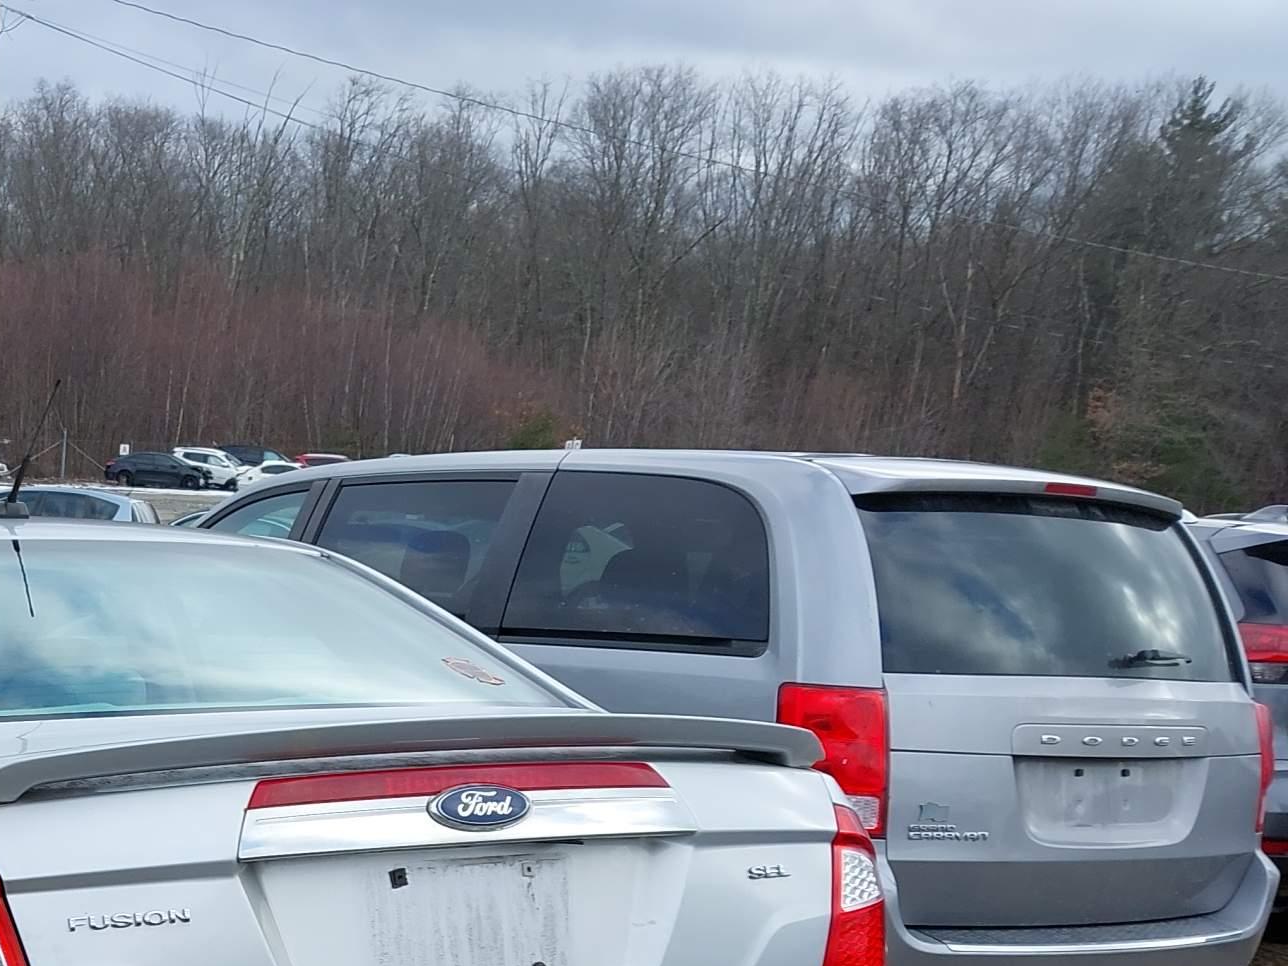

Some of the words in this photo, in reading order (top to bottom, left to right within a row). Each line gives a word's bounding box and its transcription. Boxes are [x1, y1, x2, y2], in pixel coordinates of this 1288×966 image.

[1040, 734, 1197, 746] DODGE
[457, 790, 513, 817] Ford
[908, 832, 989, 841] CARAVAN
[747, 863, 792, 880] SEL
[66, 907, 191, 932] FUSION
